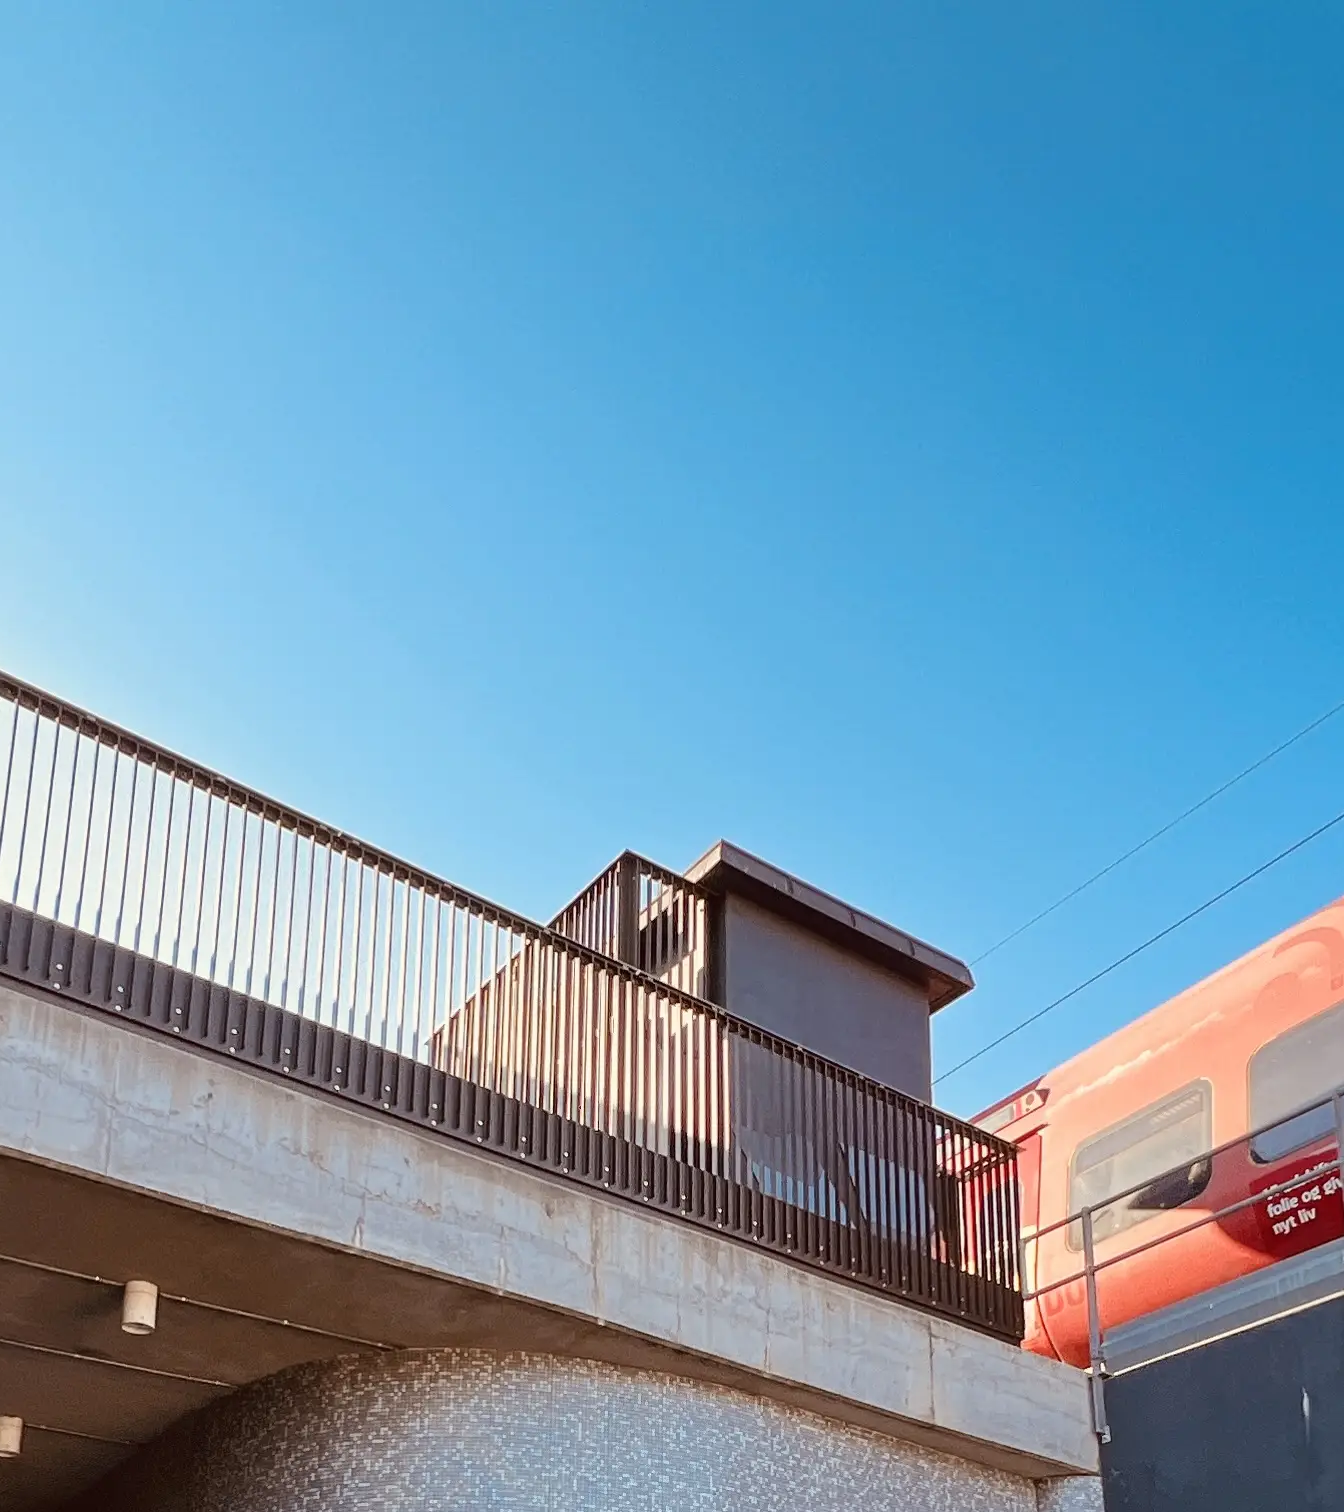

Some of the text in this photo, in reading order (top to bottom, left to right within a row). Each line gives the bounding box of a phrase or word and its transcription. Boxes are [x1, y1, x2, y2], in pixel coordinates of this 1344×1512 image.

[1267, 1196, 1298, 1217] folie
[1301, 1185, 1321, 1202] og
[1272, 1207, 1316, 1235] nyt liv
